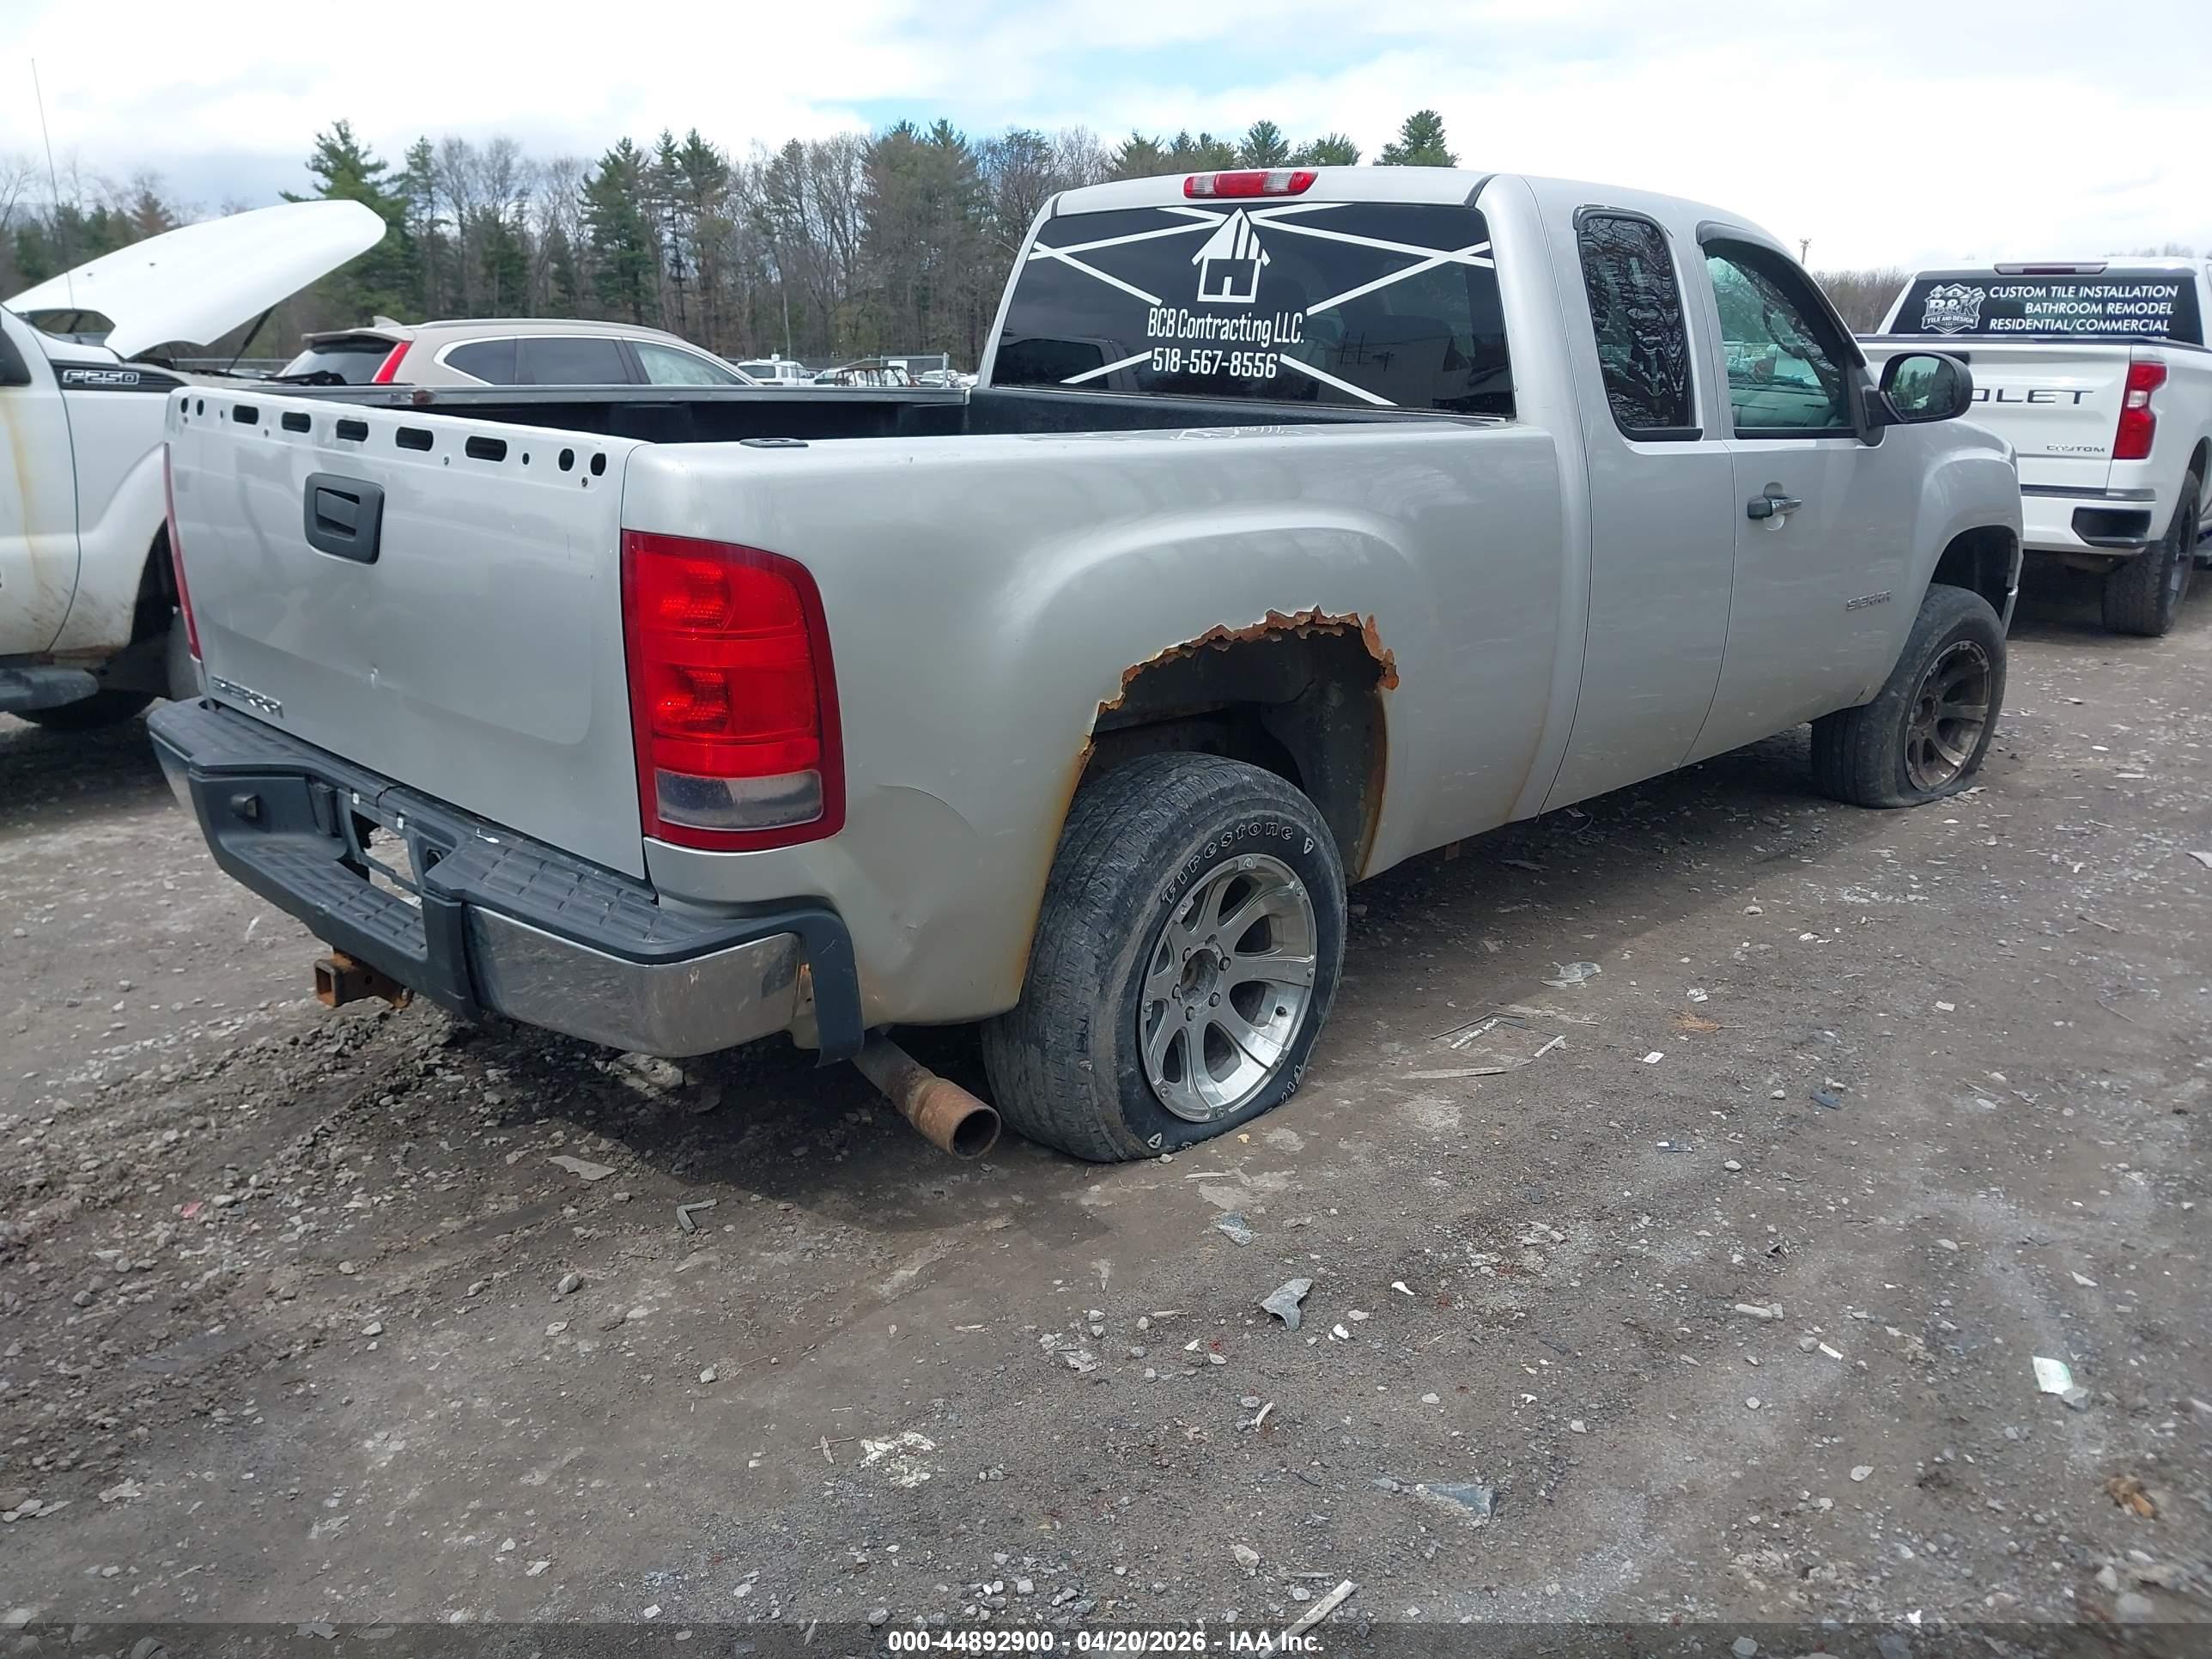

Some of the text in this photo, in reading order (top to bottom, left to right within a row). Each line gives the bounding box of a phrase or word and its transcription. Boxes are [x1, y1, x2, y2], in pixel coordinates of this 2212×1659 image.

[1989, 285, 2179, 298] CUSTOM TILE INSTALLATION
[1928, 298, 1978, 316] B&K
[2025, 302, 2174, 315] BATHROOM REMODEL
[1147, 307, 1304, 349] BCB Contracting LLC.
[1989, 319, 2171, 331] RESIDENTIAL/COMMERCIAL
[1152, 347, 1278, 379] 518-567-8556
[1161, 821, 1293, 904] Firestone
